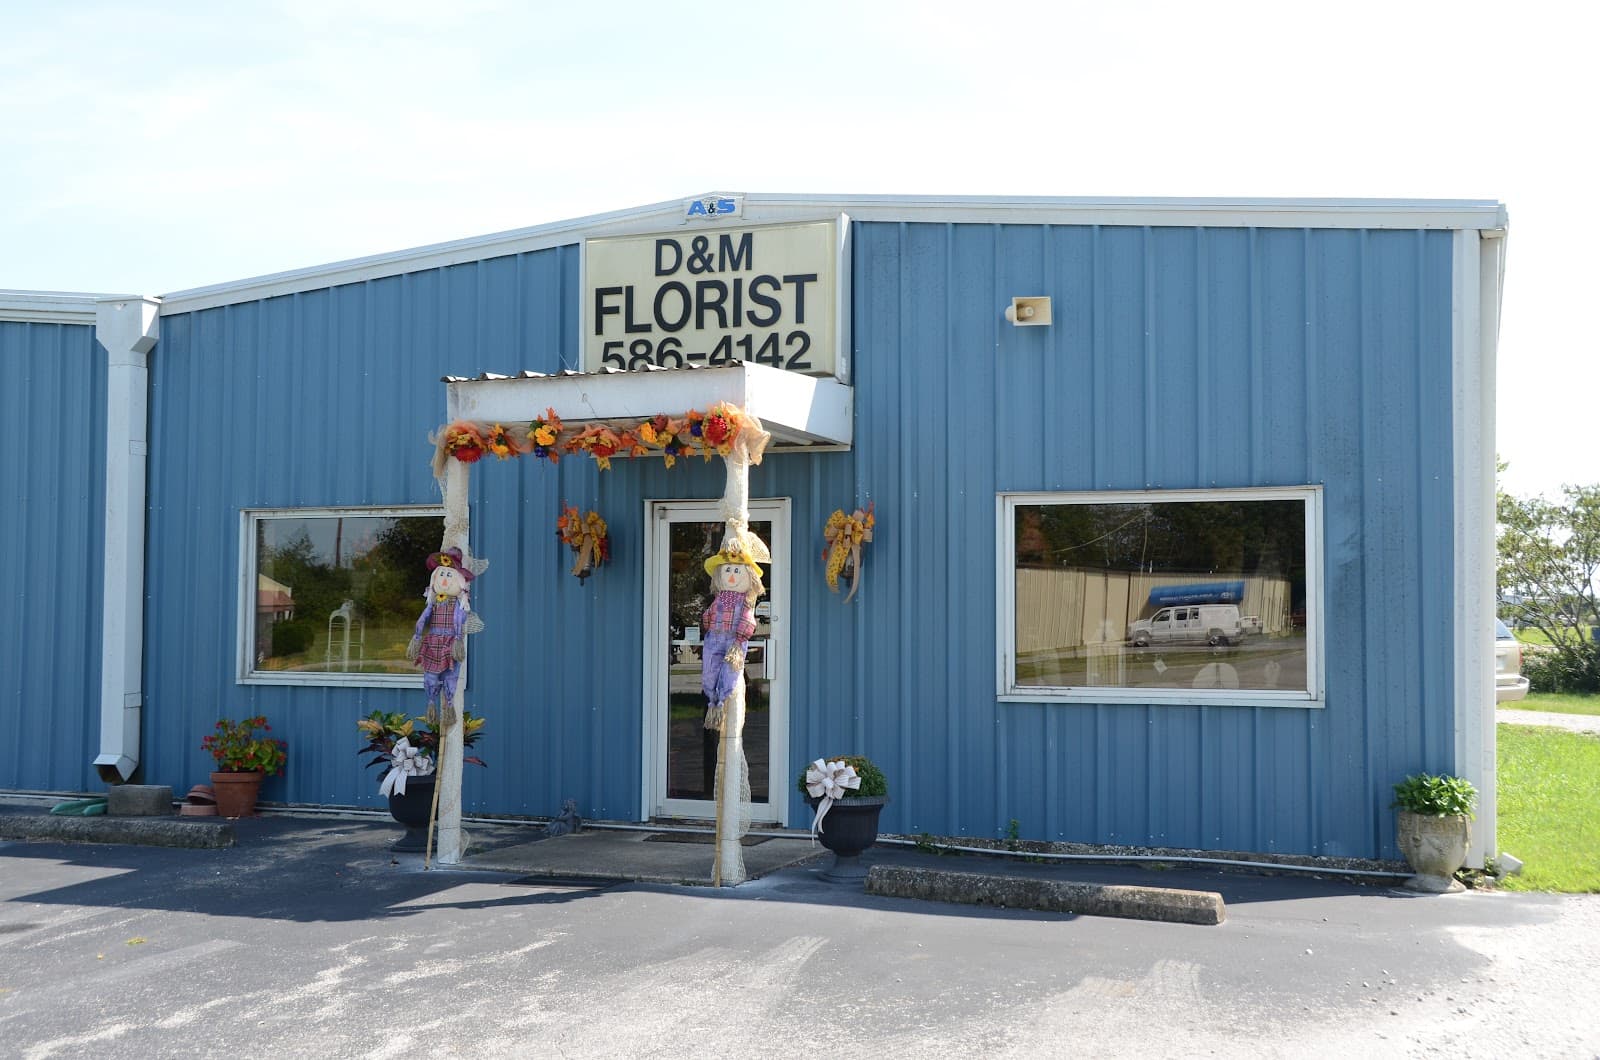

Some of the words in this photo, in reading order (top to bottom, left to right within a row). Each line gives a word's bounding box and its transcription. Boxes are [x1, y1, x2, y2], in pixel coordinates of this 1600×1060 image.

[688, 199, 735, 215] A&S
[655, 233, 753, 276] D&M
[595, 273, 818, 336] FLORIST
[602, 330, 811, 370] 586-4142
